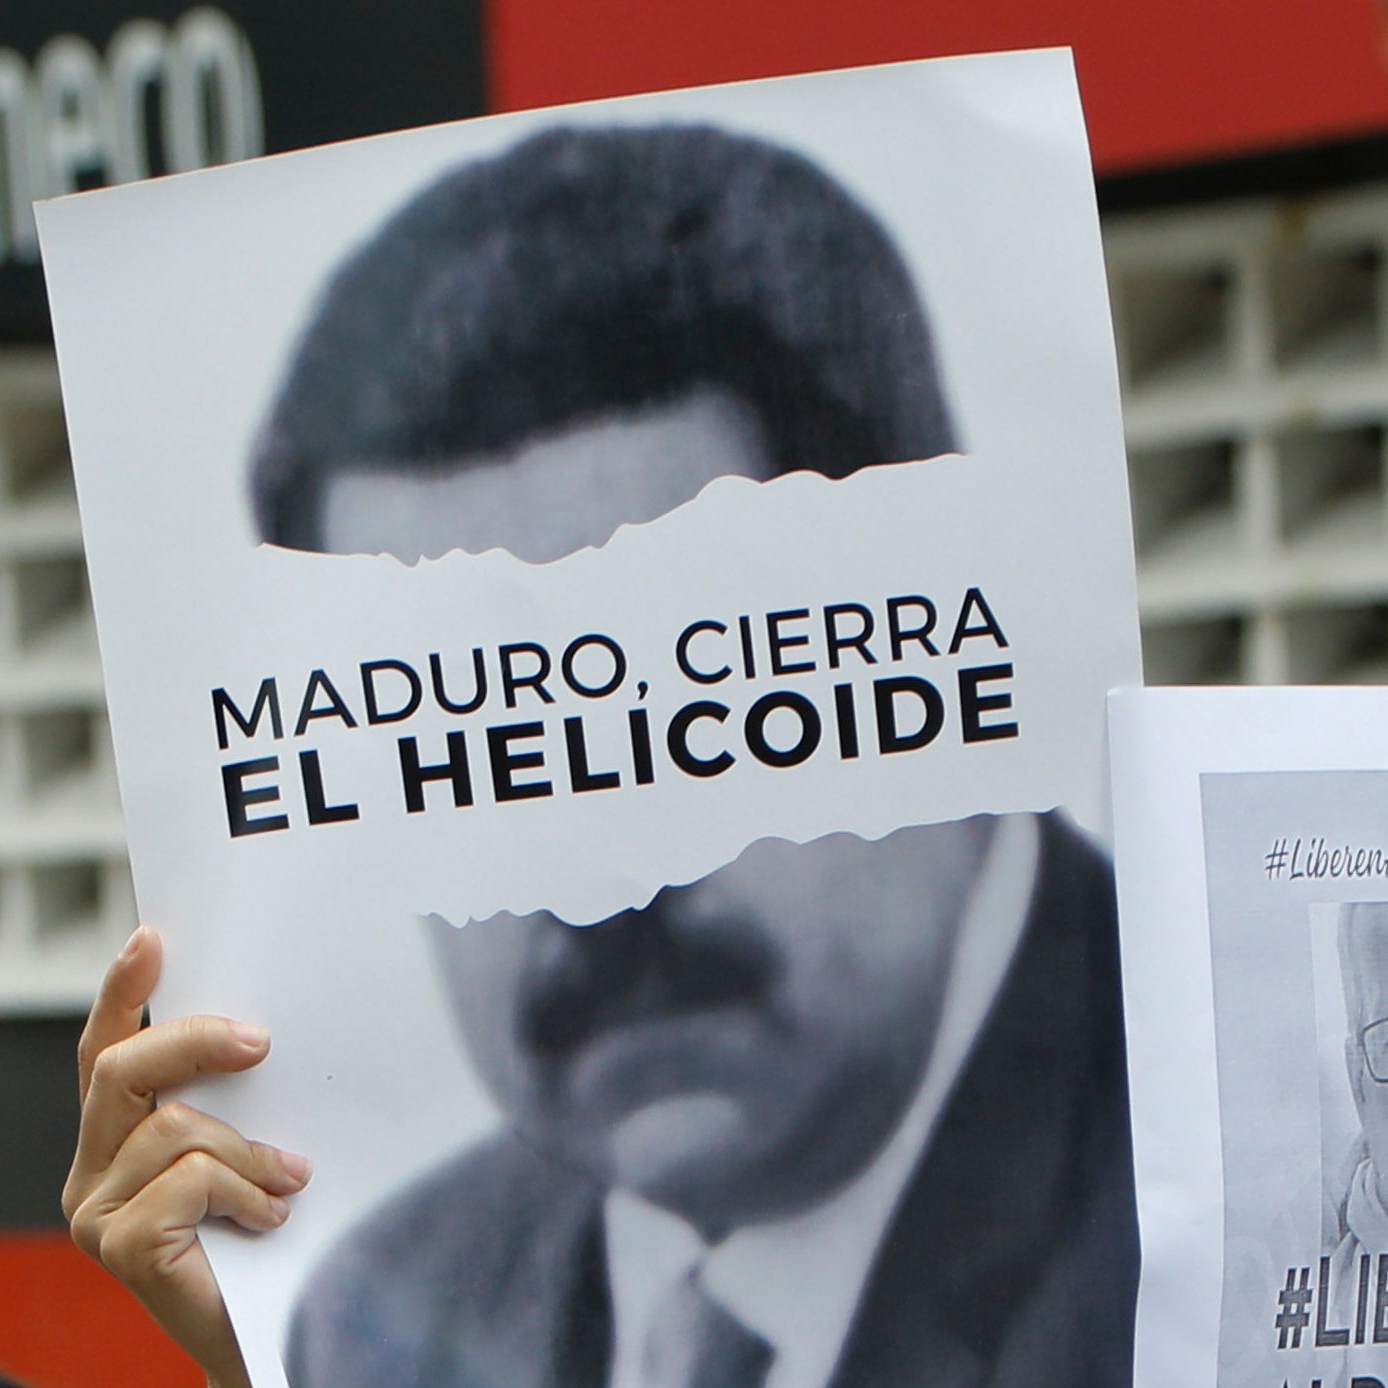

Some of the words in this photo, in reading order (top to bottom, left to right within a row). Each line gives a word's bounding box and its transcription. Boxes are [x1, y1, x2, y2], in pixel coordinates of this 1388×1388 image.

[211, 632, 650, 751] MADURO,
[674, 586, 1009, 686] CIERRA
[220, 748, 361, 839] EL
[396, 661, 1020, 815] HELICOIDE
